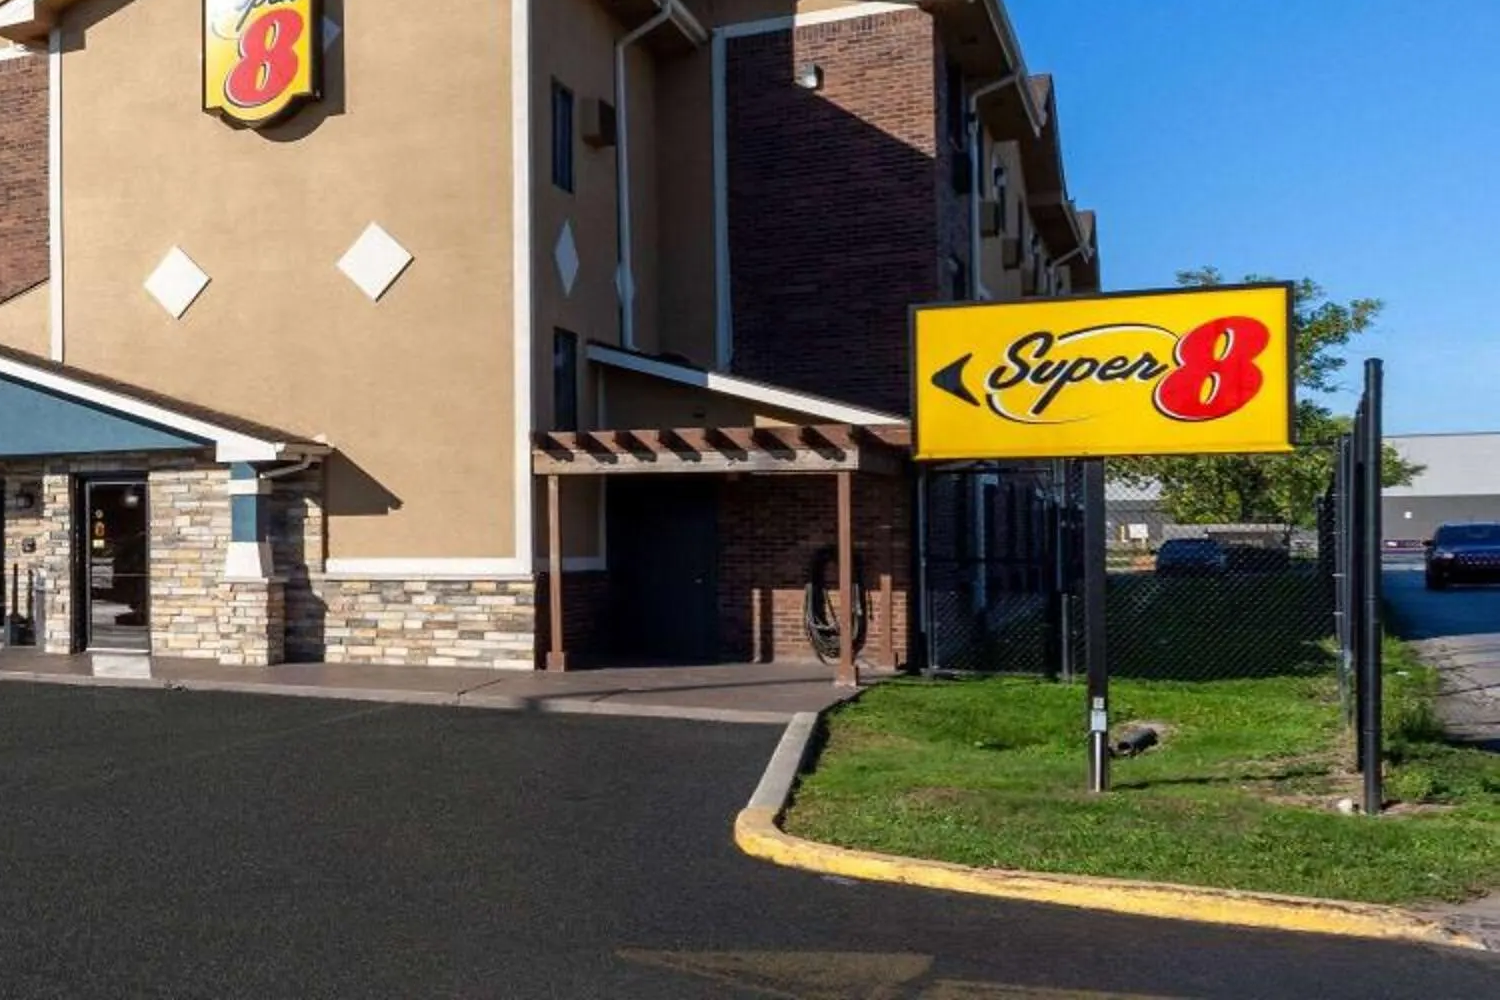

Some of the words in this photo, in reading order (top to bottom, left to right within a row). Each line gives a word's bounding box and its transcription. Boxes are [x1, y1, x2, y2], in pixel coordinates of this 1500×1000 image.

[224, 8, 305, 108] 8
[987, 331, 1170, 415] Super
[1152, 315, 1270, 422] 8
